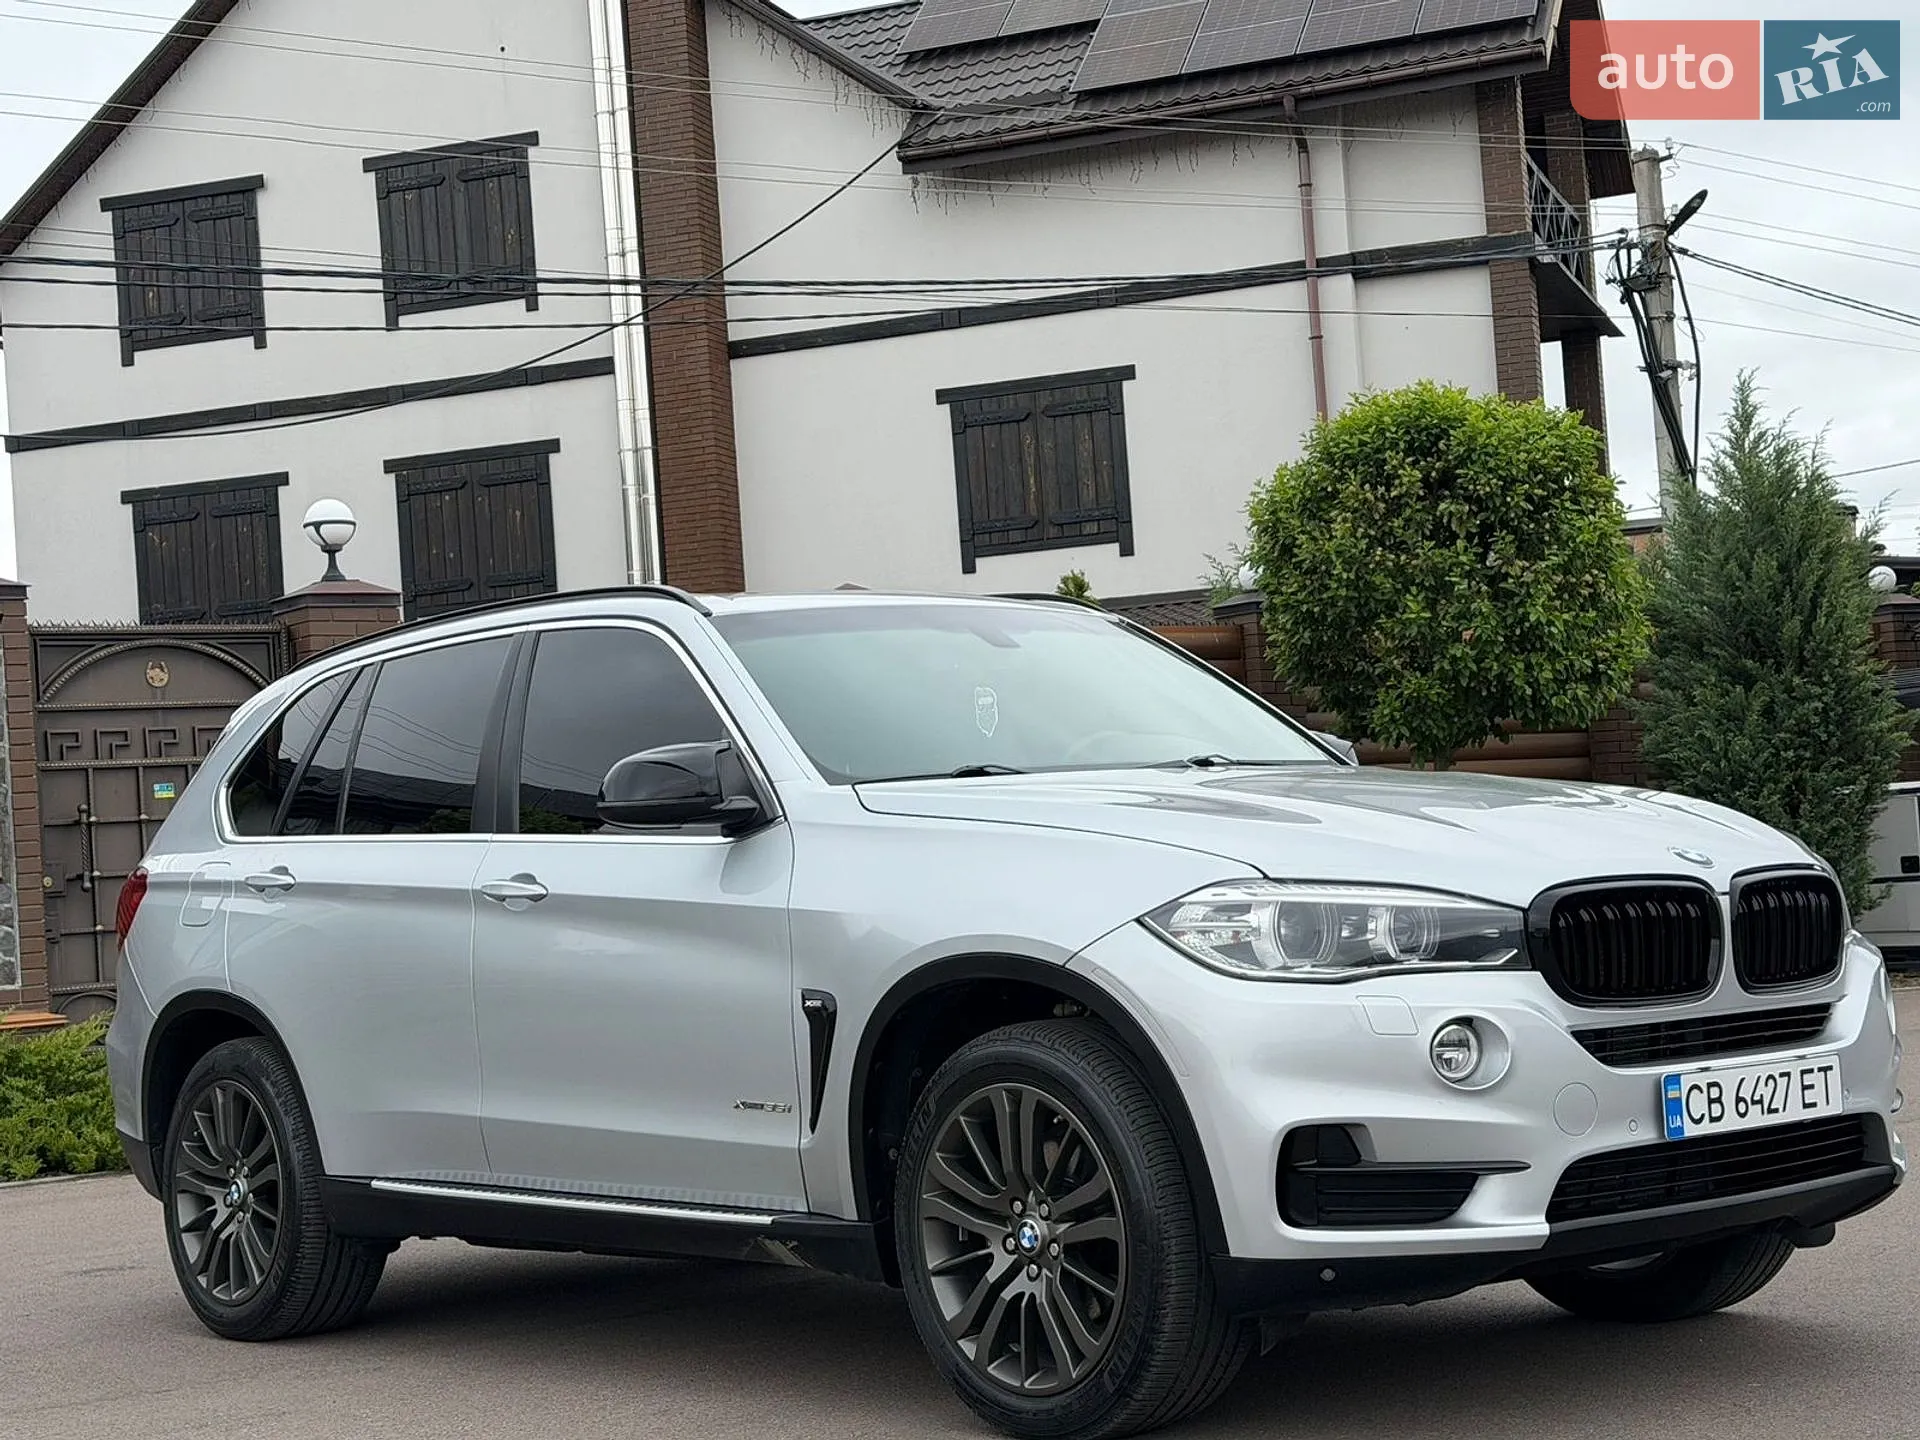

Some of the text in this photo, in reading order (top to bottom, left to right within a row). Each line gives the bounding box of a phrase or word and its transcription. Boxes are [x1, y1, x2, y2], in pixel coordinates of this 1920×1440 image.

[1685, 1065, 1834, 1125] CB 6427 ET
[1669, 1114, 1683, 1129] UA
